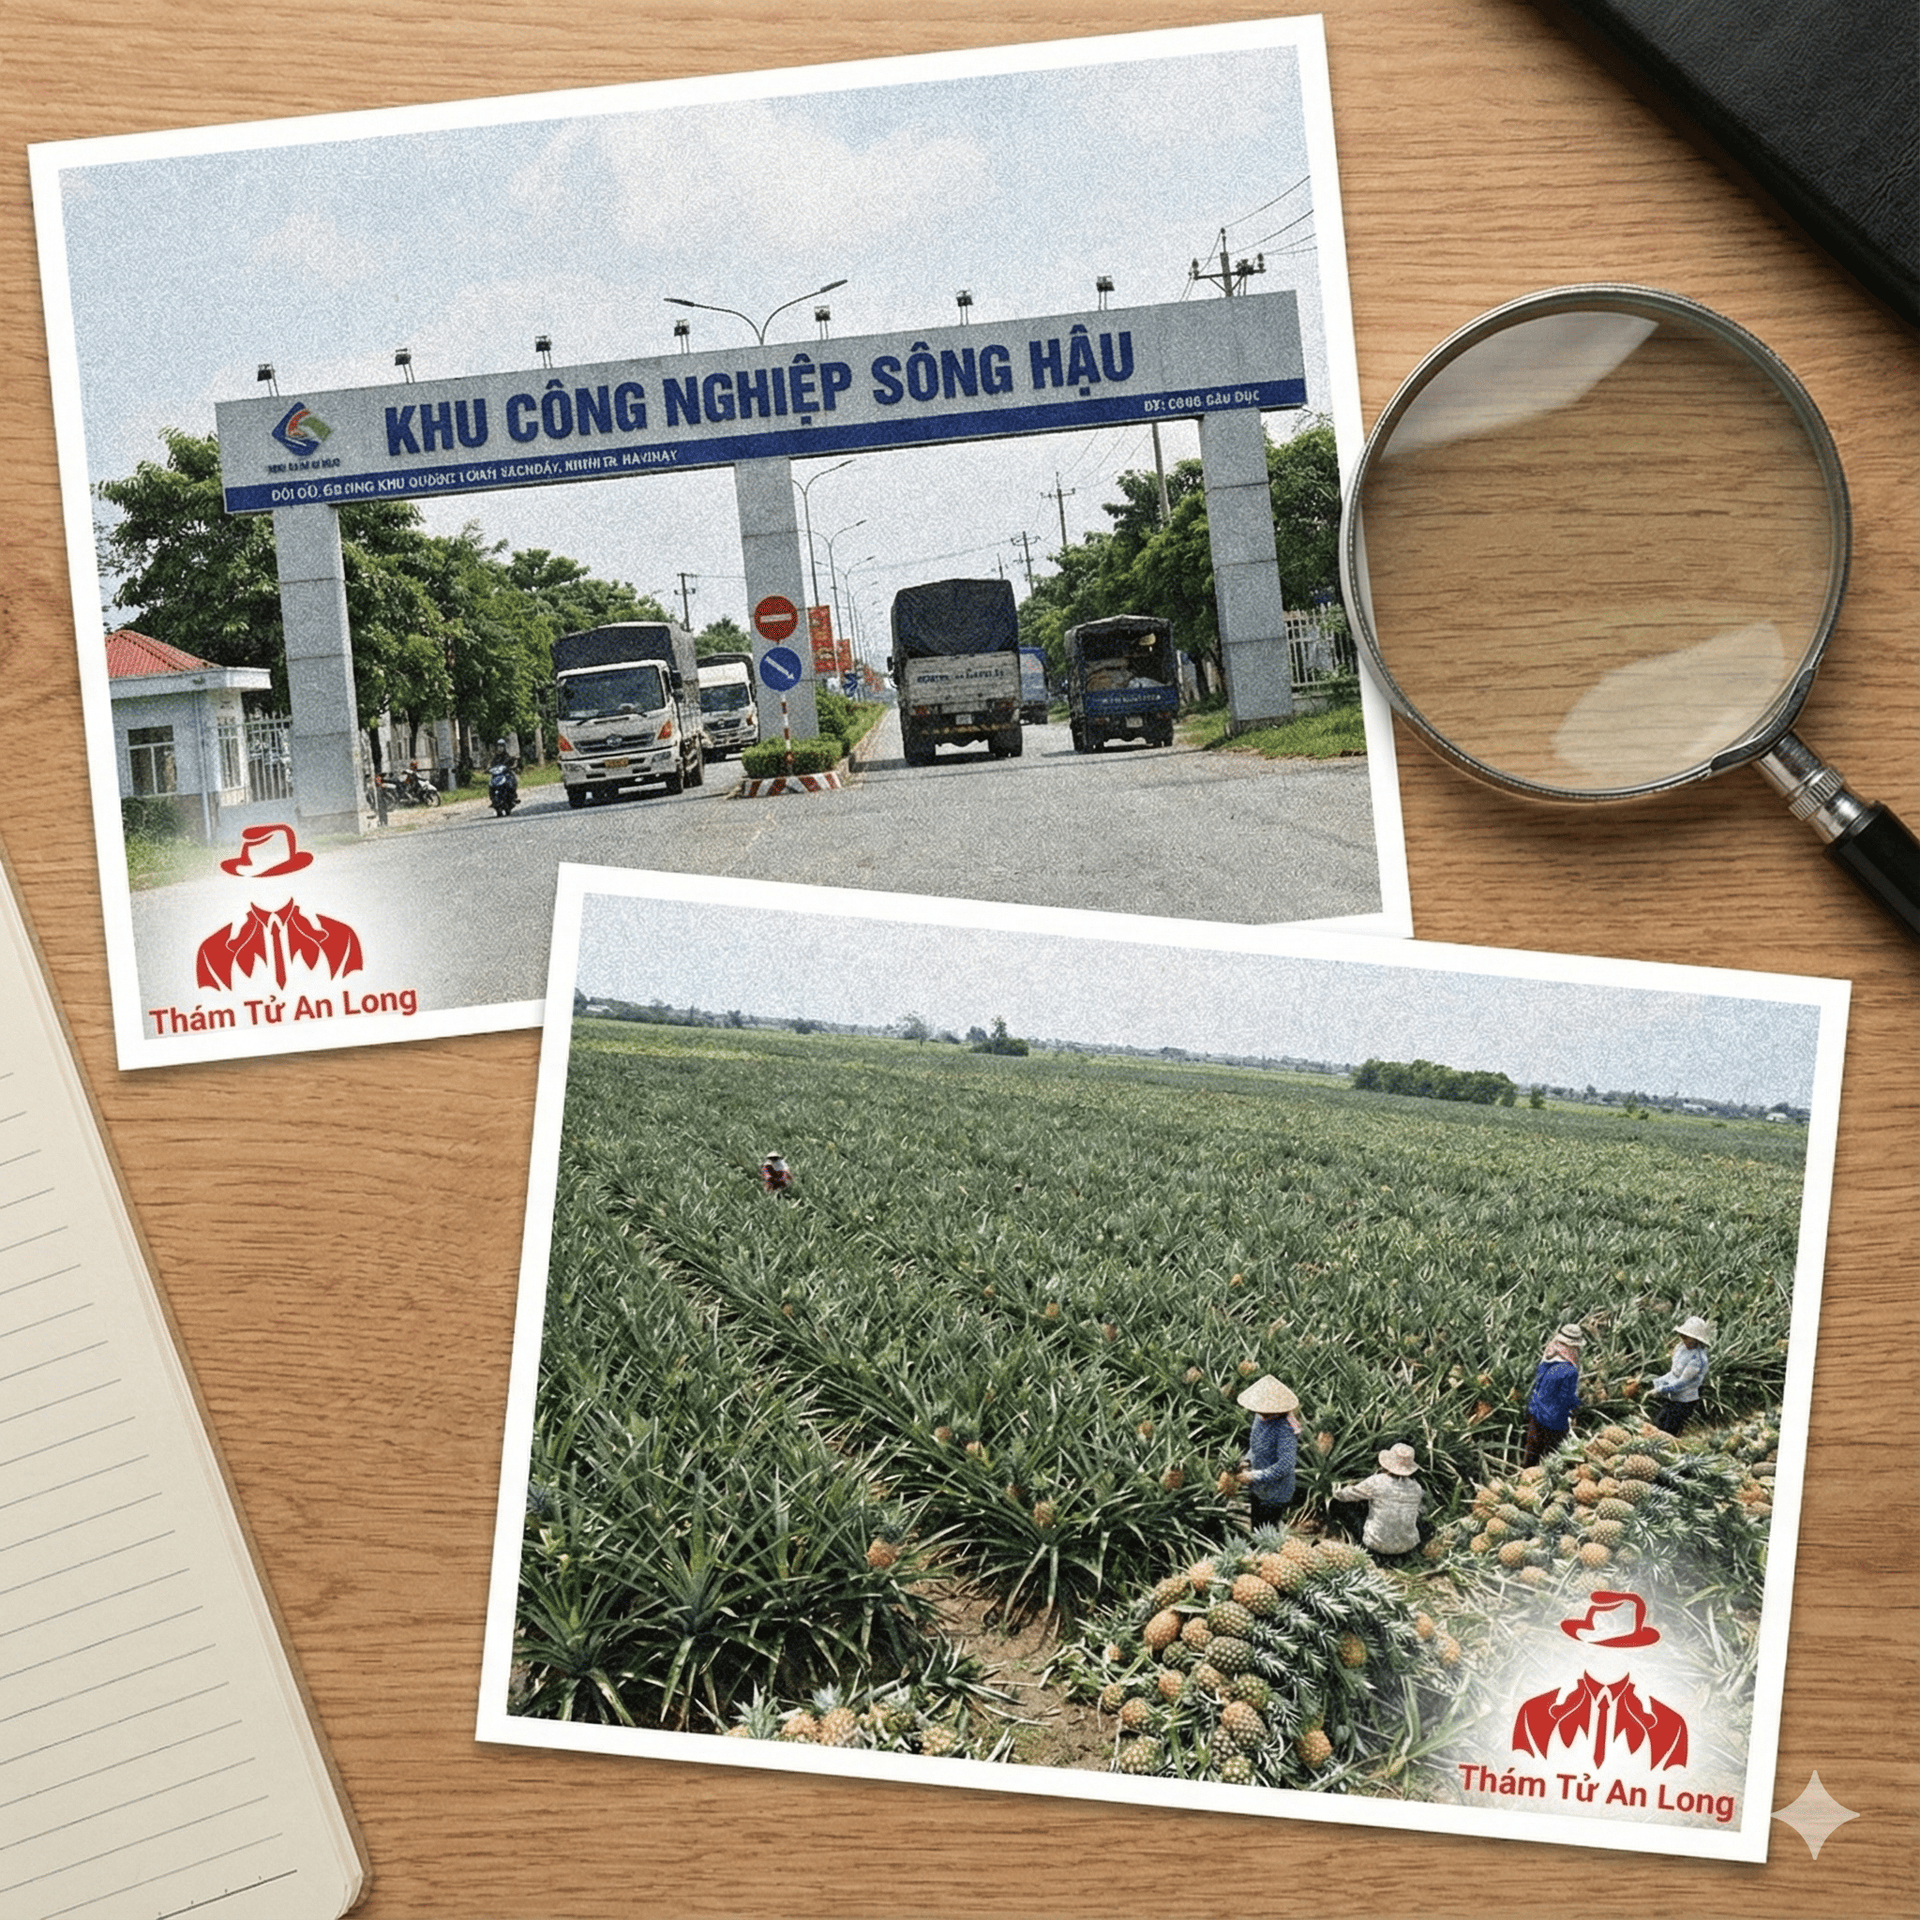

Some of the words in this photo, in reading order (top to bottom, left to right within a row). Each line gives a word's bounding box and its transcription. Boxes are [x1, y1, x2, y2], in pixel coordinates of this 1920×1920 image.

[385, 398, 488, 456] KHU
[506, 380, 647, 443] CÔNG
[662, 354, 852, 426] NGHIỆP
[871, 342, 1013, 403] SÔNG
[1029, 324, 1134, 396] HẬU
